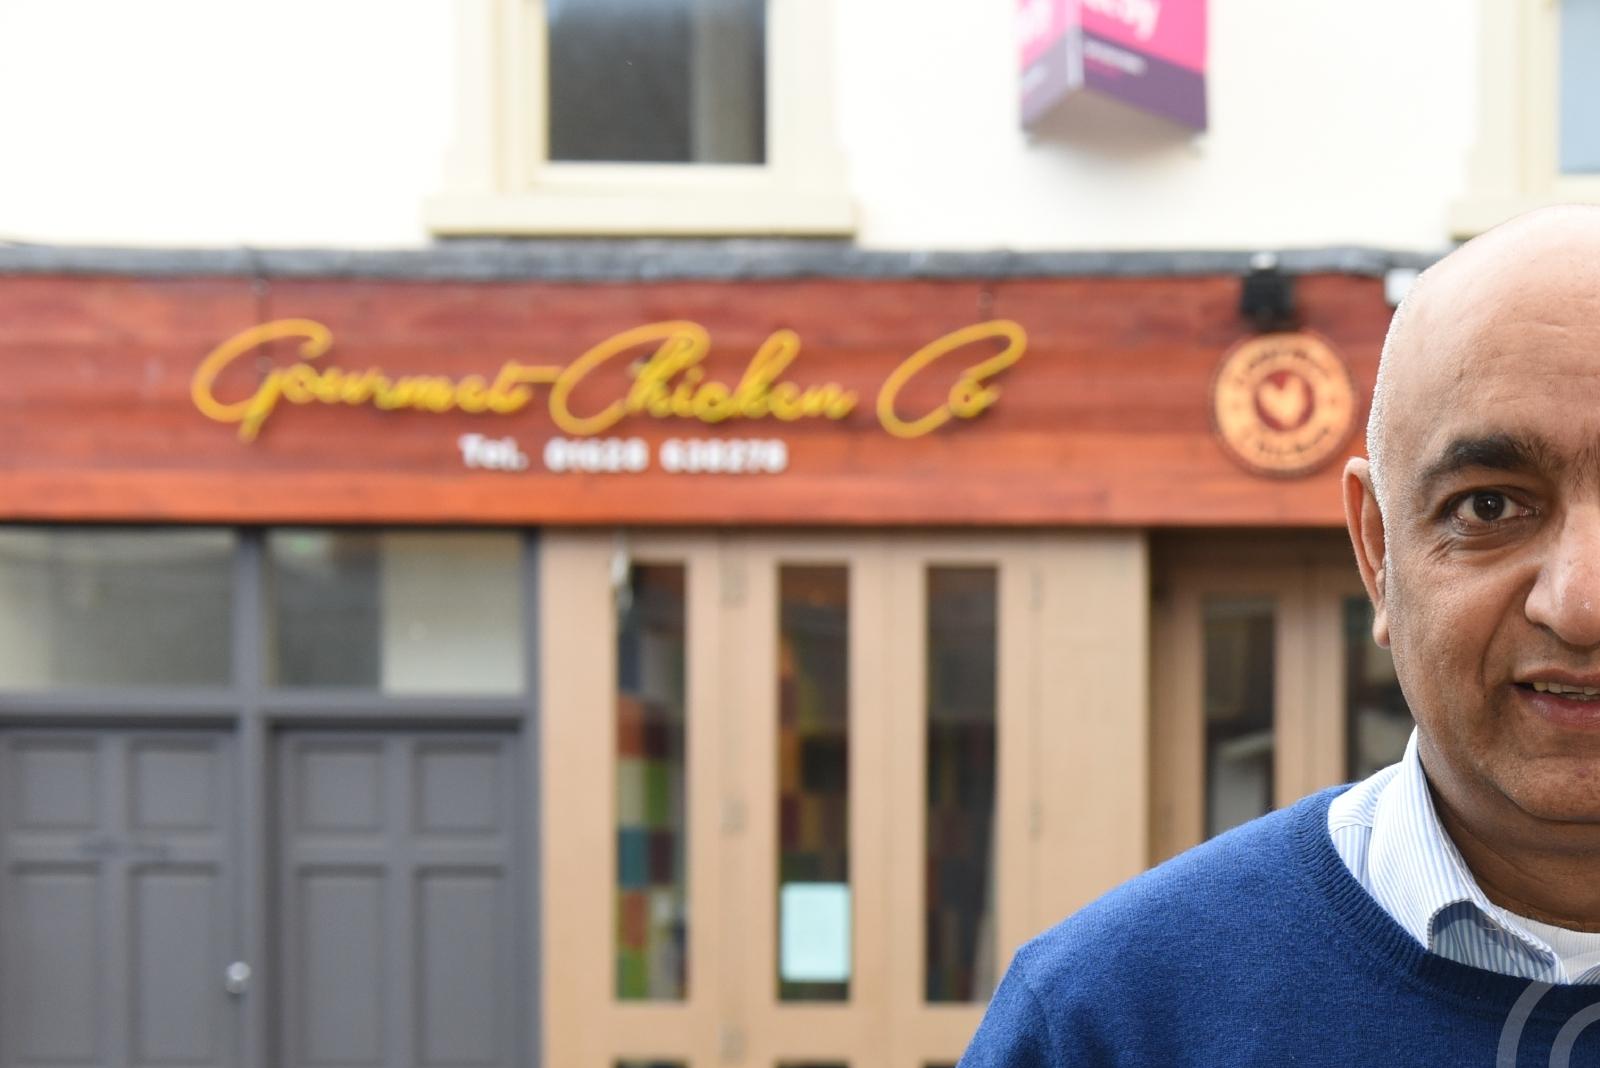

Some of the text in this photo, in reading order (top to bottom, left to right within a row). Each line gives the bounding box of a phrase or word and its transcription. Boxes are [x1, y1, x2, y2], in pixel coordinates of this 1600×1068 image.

[192, 318, 1027, 443] Gourmet Chicken Co
[458, 434, 528, 472] Tel.
